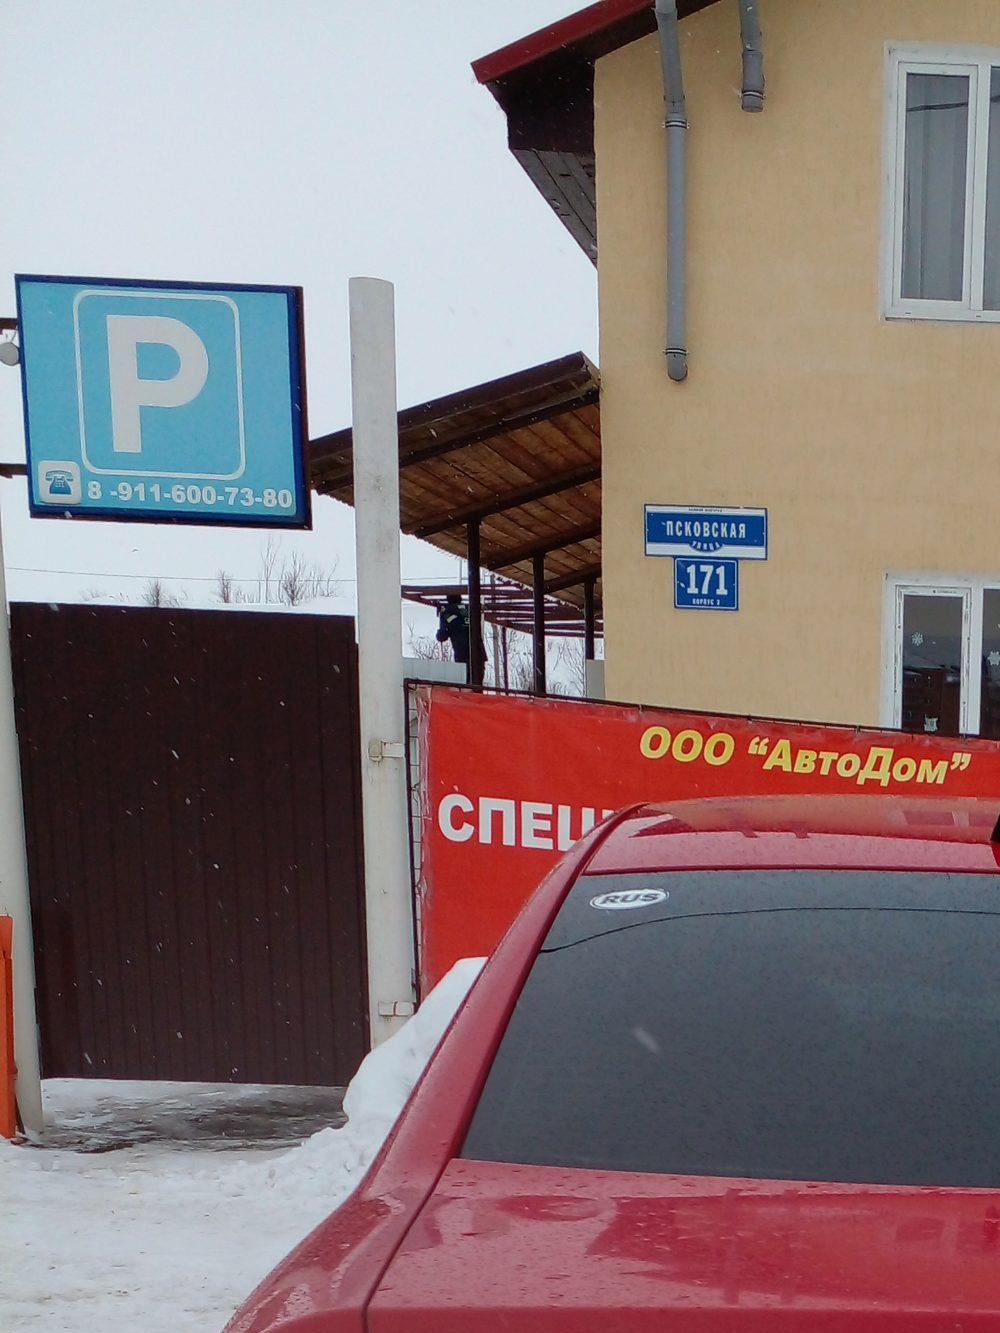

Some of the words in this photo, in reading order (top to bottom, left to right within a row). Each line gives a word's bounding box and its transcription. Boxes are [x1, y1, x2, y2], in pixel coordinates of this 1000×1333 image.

[106, 314, 209, 453] P
[666, 520, 746, 538] ПСКОВСКАЯ
[686, 564, 728, 595] 171
[640, 726, 735, 766] ООО
[437, 793, 614, 851] СПЕЦ
[601, 893, 661, 905] RUS
